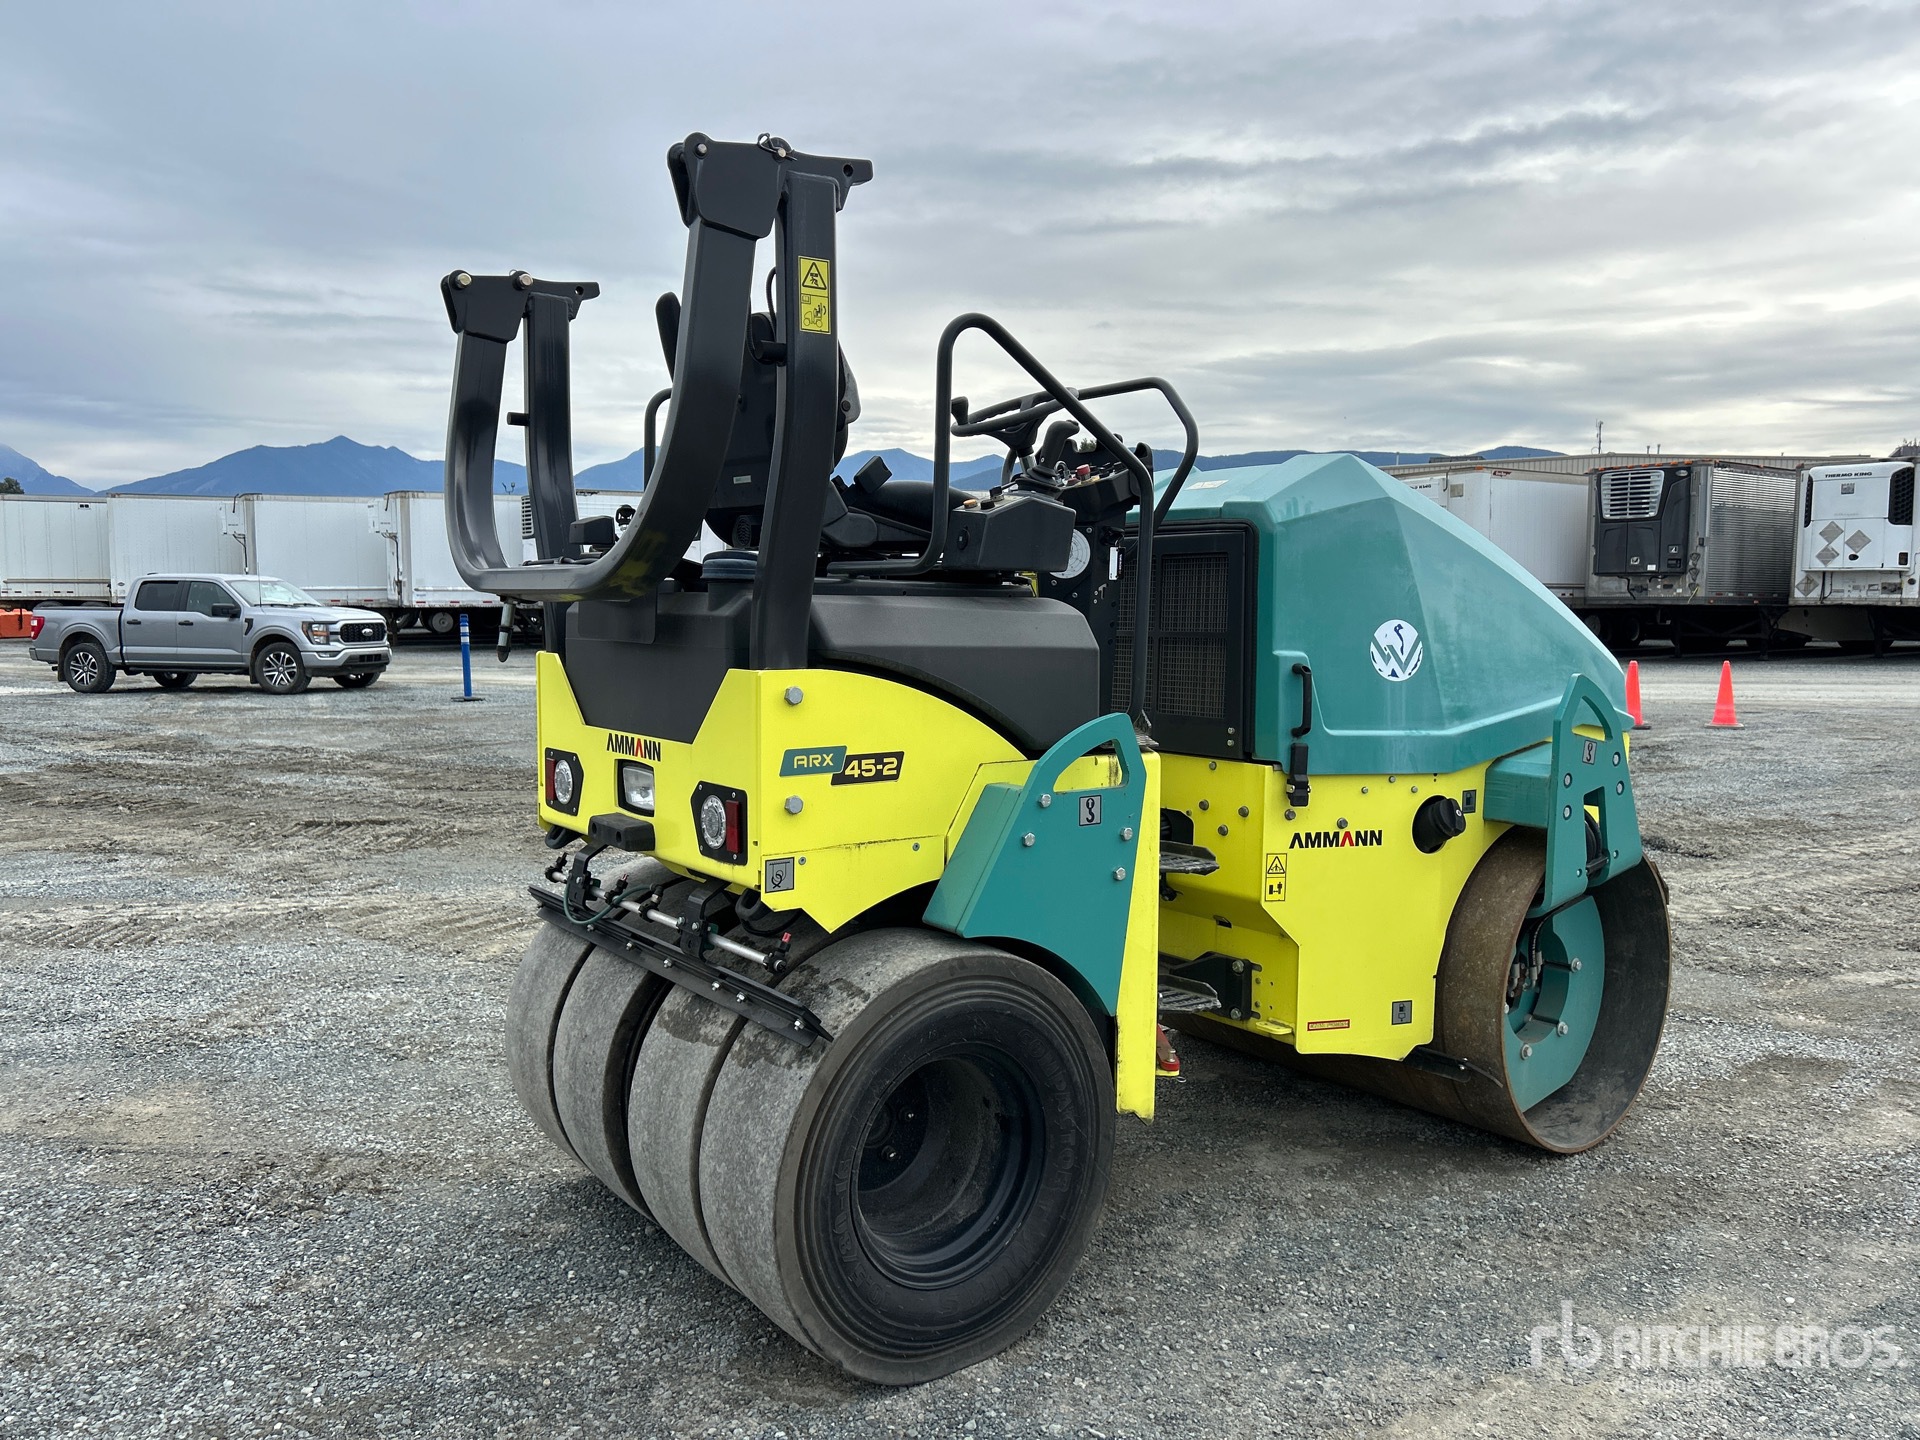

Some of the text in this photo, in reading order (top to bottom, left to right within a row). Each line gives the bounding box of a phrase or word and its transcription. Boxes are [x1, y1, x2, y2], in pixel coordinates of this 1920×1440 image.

[607, 733, 661, 762] AMMANN
[793, 753, 898, 779] ARX 45-2
[1289, 830, 1383, 849] AMMANN
